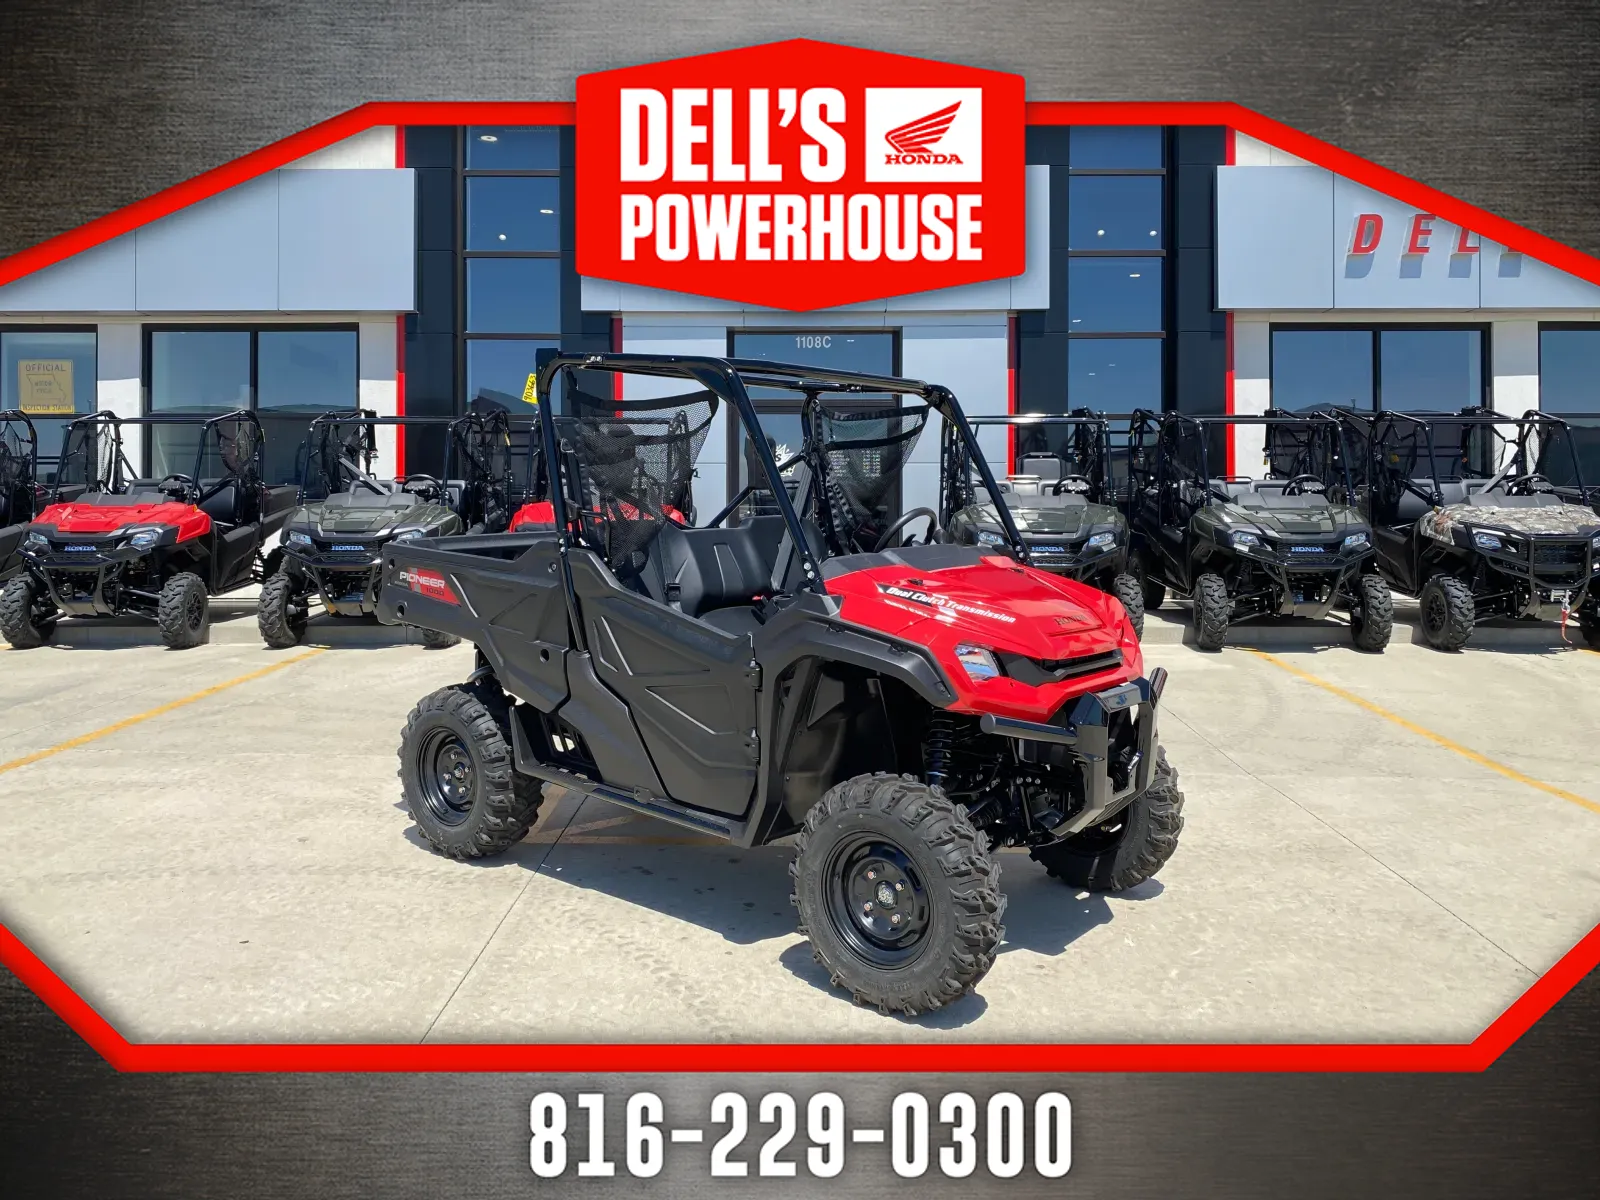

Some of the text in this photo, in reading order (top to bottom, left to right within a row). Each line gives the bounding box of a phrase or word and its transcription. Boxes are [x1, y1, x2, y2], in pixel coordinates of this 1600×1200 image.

[1351, 214, 1523, 255] DEL
[795, 335, 832, 349] 1108C
[25, 363, 67, 372] OFFICIAL
[399, 571, 446, 589] PIONEER
[425, 587, 445, 597] 1000
[886, 586, 913, 598] Dual
[911, 592, 946, 606] Clutch
[945, 600, 1017, 624] Transmission
